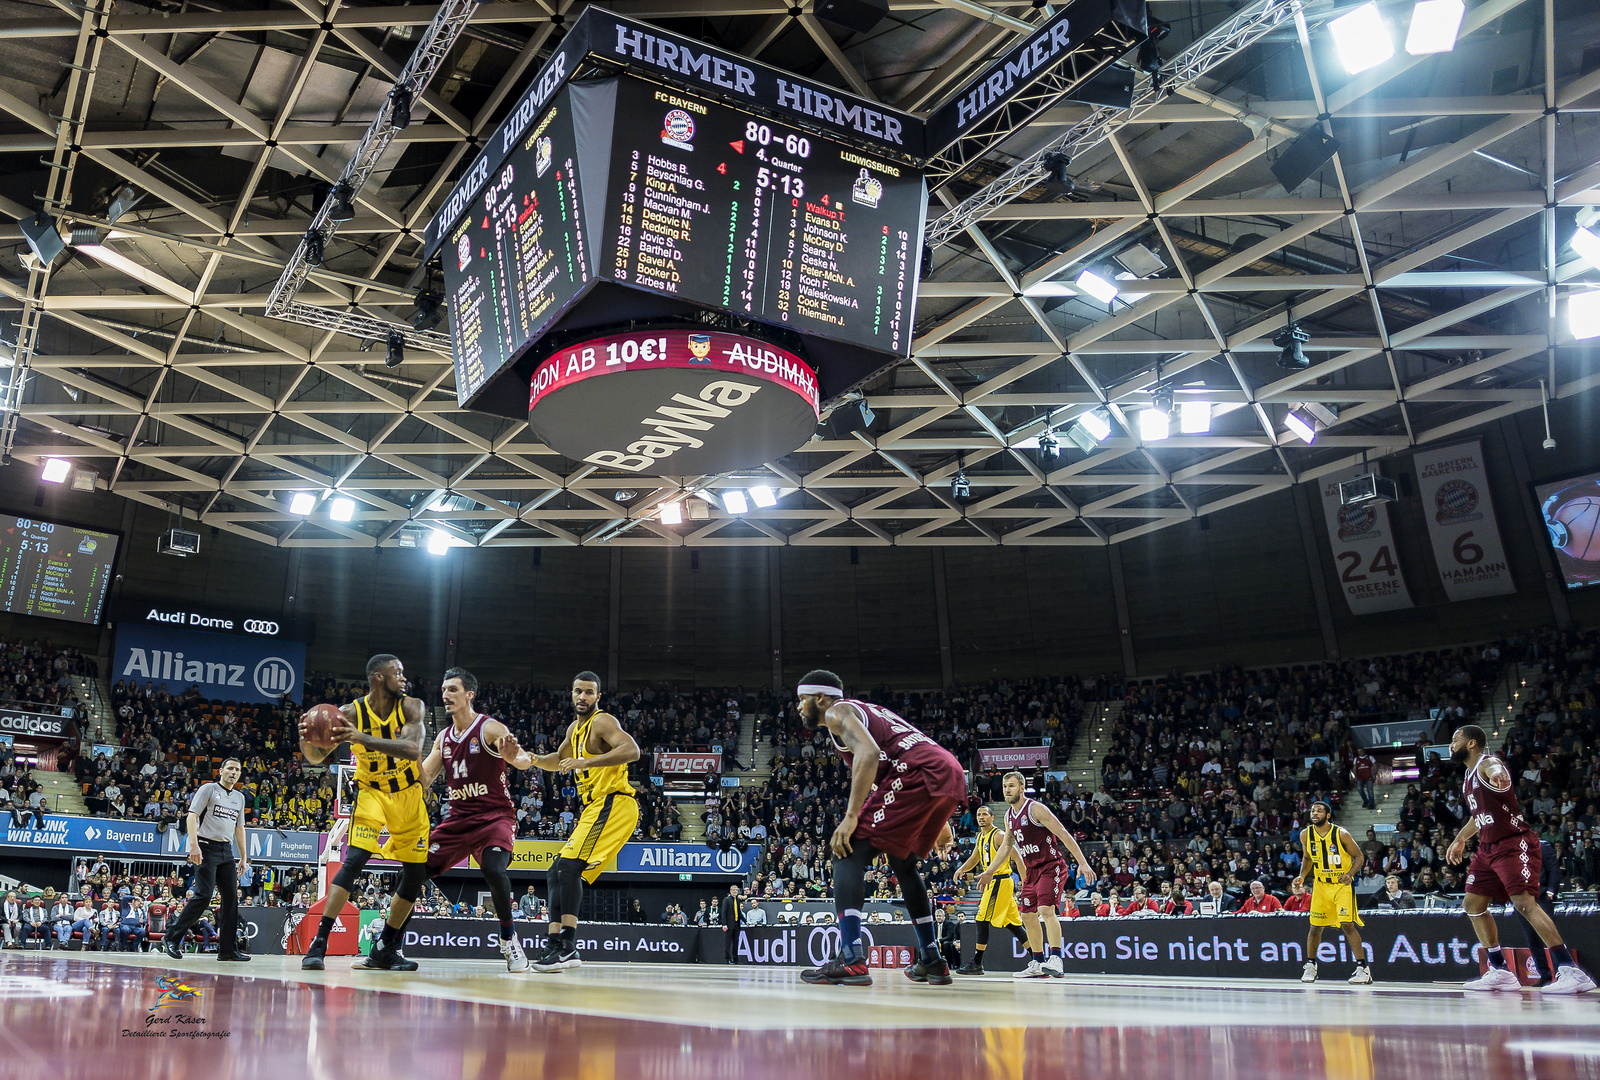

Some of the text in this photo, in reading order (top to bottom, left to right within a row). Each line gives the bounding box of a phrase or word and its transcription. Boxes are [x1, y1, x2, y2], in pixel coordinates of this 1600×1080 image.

[616, 24, 902, 144] HIRMER HIRMER
[958, 19, 1069, 128] HIRMER
[655, 91, 707, 114] FC BAYERN
[437, 51, 565, 239] HIRMER HIRMER
[746, 121, 811, 158] 80-60
[632, 150, 689, 174] 3 Hobbs B.
[717, 162, 726, 174] 4
[756, 148, 802, 173] 4. Quarter
[841, 150, 900, 177] LUDWIGSBURG
[630, 171, 677, 193] 7 King A.
[631, 161, 705, 190] 5 Beyschlag G.
[757, 167, 804, 198] 5:13
[485, 164, 514, 211] 80-60
[629, 182, 710, 214] 9 Cunningham J.
[623, 192, 692, 219] 13 Macvan M.
[820, 194, 830, 206] 4
[495, 203, 517, 240] 5:13
[622, 203, 691, 230] 14 Dedovic N.
[805, 212, 841, 231] Evans D.
[806, 202, 846, 222] Walkup T.
[620, 225, 676, 248] 16 Jovic S.
[621, 214, 691, 241] 15 Redding R.
[804, 223, 848, 244] Johnson K.
[618, 236, 683, 261] 22 Barthel D.
[788, 239, 835, 260] 5 Sears J.
[789, 229, 844, 252] 4 McCray D.
[616, 246, 676, 270] 25 Gavel A.
[616, 257, 681, 282] 31 Booker D.
[788, 249, 839, 272] 7 Geske N.
[614, 268, 677, 293] 33 Zirbes M.
[781, 269, 830, 290] 12 Koch F.
[782, 259, 855, 287] 10 Peter-McN. A.
[778, 290, 829, 311] 23 Cook E.
[780, 280, 858, 309] 19 Waleskowski A
[778, 300, 845, 326] 32 Thiemann J.
[566, 348, 595, 376] AB
[606, 338, 666, 366] 10€!
[729, 343, 814, 398] AUDIMAX
[583, 380, 761, 472] BayWa
[1422, 463, 1478, 478] BASKETBALL
[1438, 456, 1473, 468] BAYERN
[16, 518, 54, 533] 80-60
[21, 540, 48, 553] 5:13
[1453, 531, 1484, 565] 6
[1337, 546, 1398, 583] 24
[1442, 562, 1506, 580] HAMANN
[1348, 580, 1400, 594] GREENE
[146, 609, 233, 629] Audi Dome
[123, 648, 245, 686] Allianz
[0, 715, 62, 733] adidas
[452, 759, 468, 779] 14
[660, 754, 715, 771] tipico
[991, 754, 1025, 762] TELEKOM
[8, 830, 69, 845] WIR BANK.
[106, 830, 140, 843] Bayern
[280, 842, 312, 851] Flughafen
[512, 852, 544, 862] tsche
[640, 848, 711, 867] Allianz
[1328, 854, 1342, 865] 10
[405, 931, 480, 947] Denken
[523, 934, 548, 948] nic
[576, 938, 597, 950] an
[603, 936, 632, 951] ein
[636, 938, 684, 952] Auto.
[737, 930, 796, 963] Audi
[1012, 936, 1106, 959] Dken
[1115, 936, 1158, 960] Sie
[1168, 935, 1249, 961] nicht
[1260, 942, 1302, 962] an
